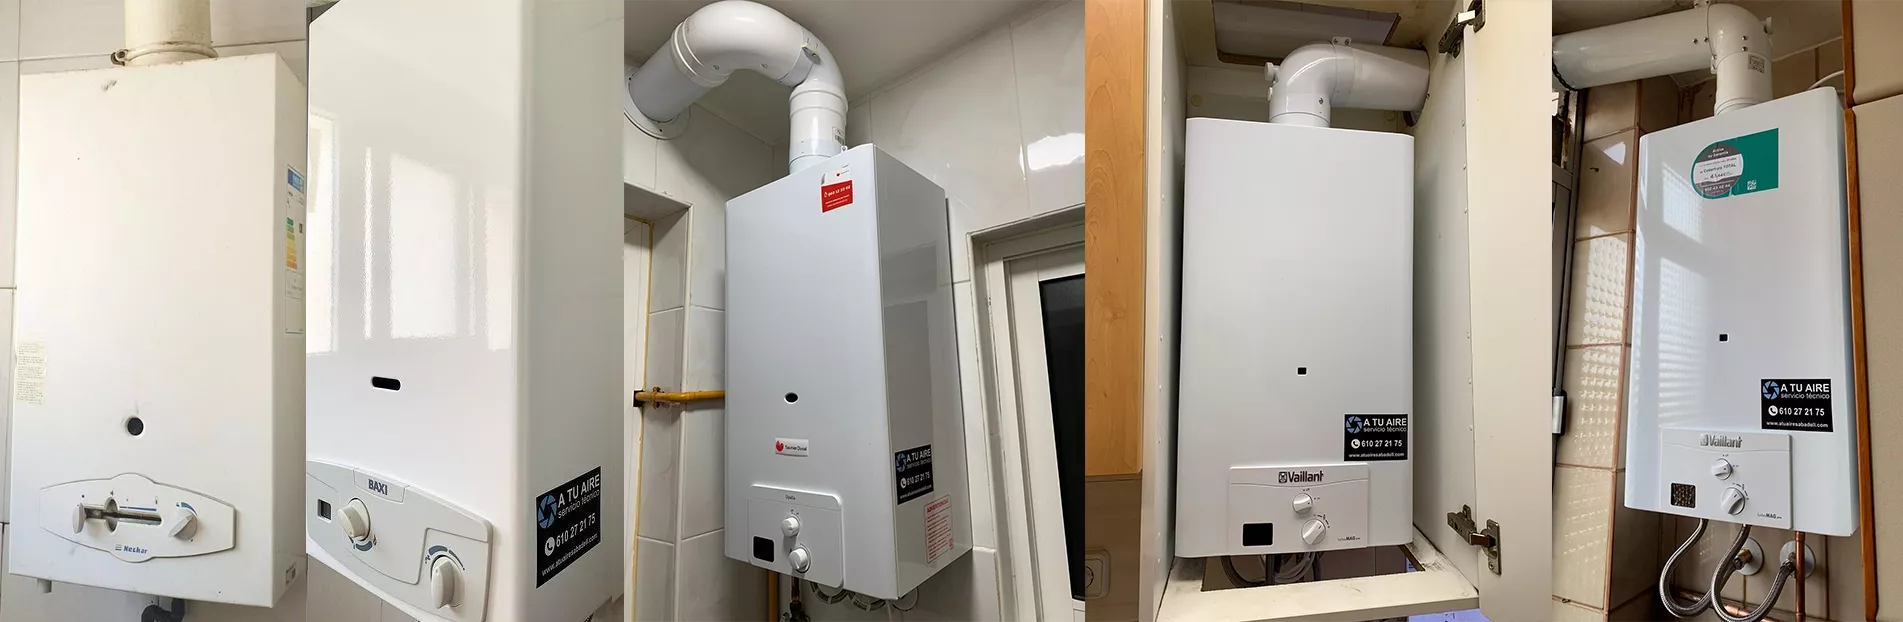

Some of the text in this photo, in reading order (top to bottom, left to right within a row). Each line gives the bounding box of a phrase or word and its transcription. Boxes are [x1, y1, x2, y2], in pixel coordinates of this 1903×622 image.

[1780, 384, 1830, 392] A TU AIRE
[1815, 408, 1825, 416] 75
[1372, 418, 1384, 426] TU
[1386, 418, 1407, 426] AIRE
[1710, 435, 1742, 448] Vaillant
[906, 448, 931, 462] A TU AIRE
[915, 474, 921, 482] 27
[1288, 470, 1324, 482] Vaillant
[368, 479, 388, 495] BAXI
[558, 474, 600, 508] A TU AIRE
[558, 490, 600, 518] servicio técnico
[556, 513, 596, 547] 610 27 21 75
[124, 546, 148, 554] Neckar
[542, 533, 598, 576] www.atuairesabadell.com
